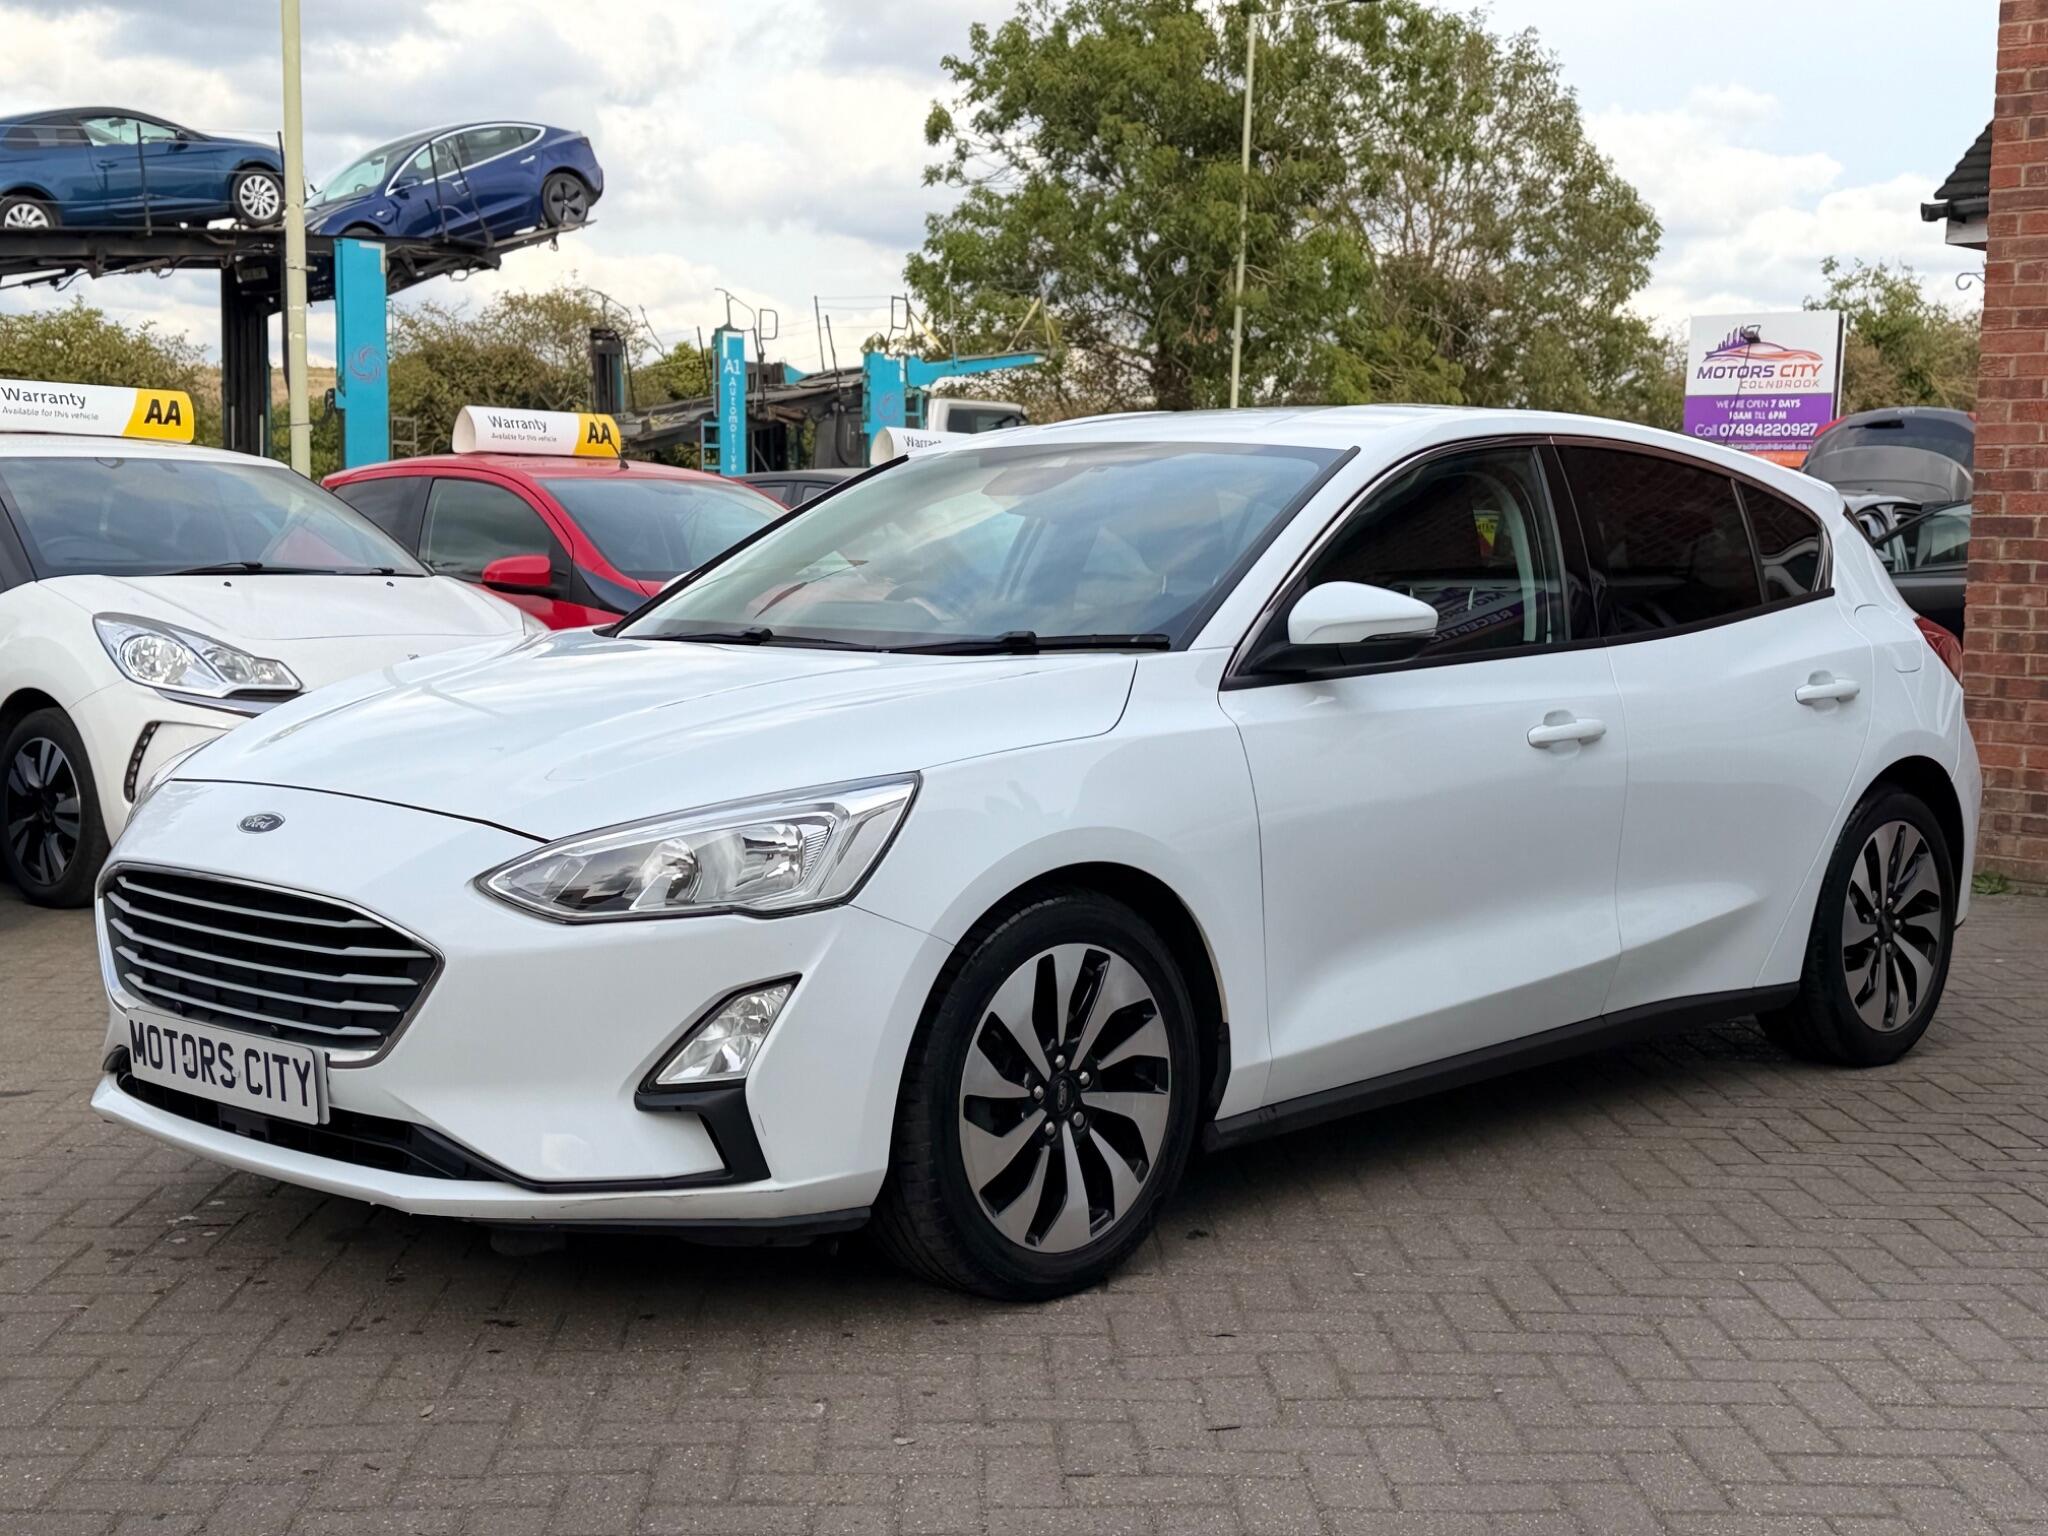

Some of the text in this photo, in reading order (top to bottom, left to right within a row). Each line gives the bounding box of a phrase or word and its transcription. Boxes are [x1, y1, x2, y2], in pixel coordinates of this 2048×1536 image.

[723, 359, 741, 375] A1
[1696, 363, 1823, 379] MOTORS CITY
[1740, 379, 1819, 389] COLNBROOK
[1, 386, 86, 409] Warranty
[1715, 400, 1729, 409] WE
[1746, 399, 1768, 409] OPEN
[1770, 399, 1778, 409] 7
[1778, 399, 1801, 408] DAYS
[2, 406, 99, 421] Available for this vehicle
[144, 399, 181, 426] AA
[1768, 411, 1787, 419] 6PM
[488, 415, 547, 433] Warranty
[1695, 423, 1818, 437] Call 07494220927
[586, 422, 612, 444] AA
[245, 815, 275, 829] Ford
[129, 1019, 311, 1107] MOTORS CITY
